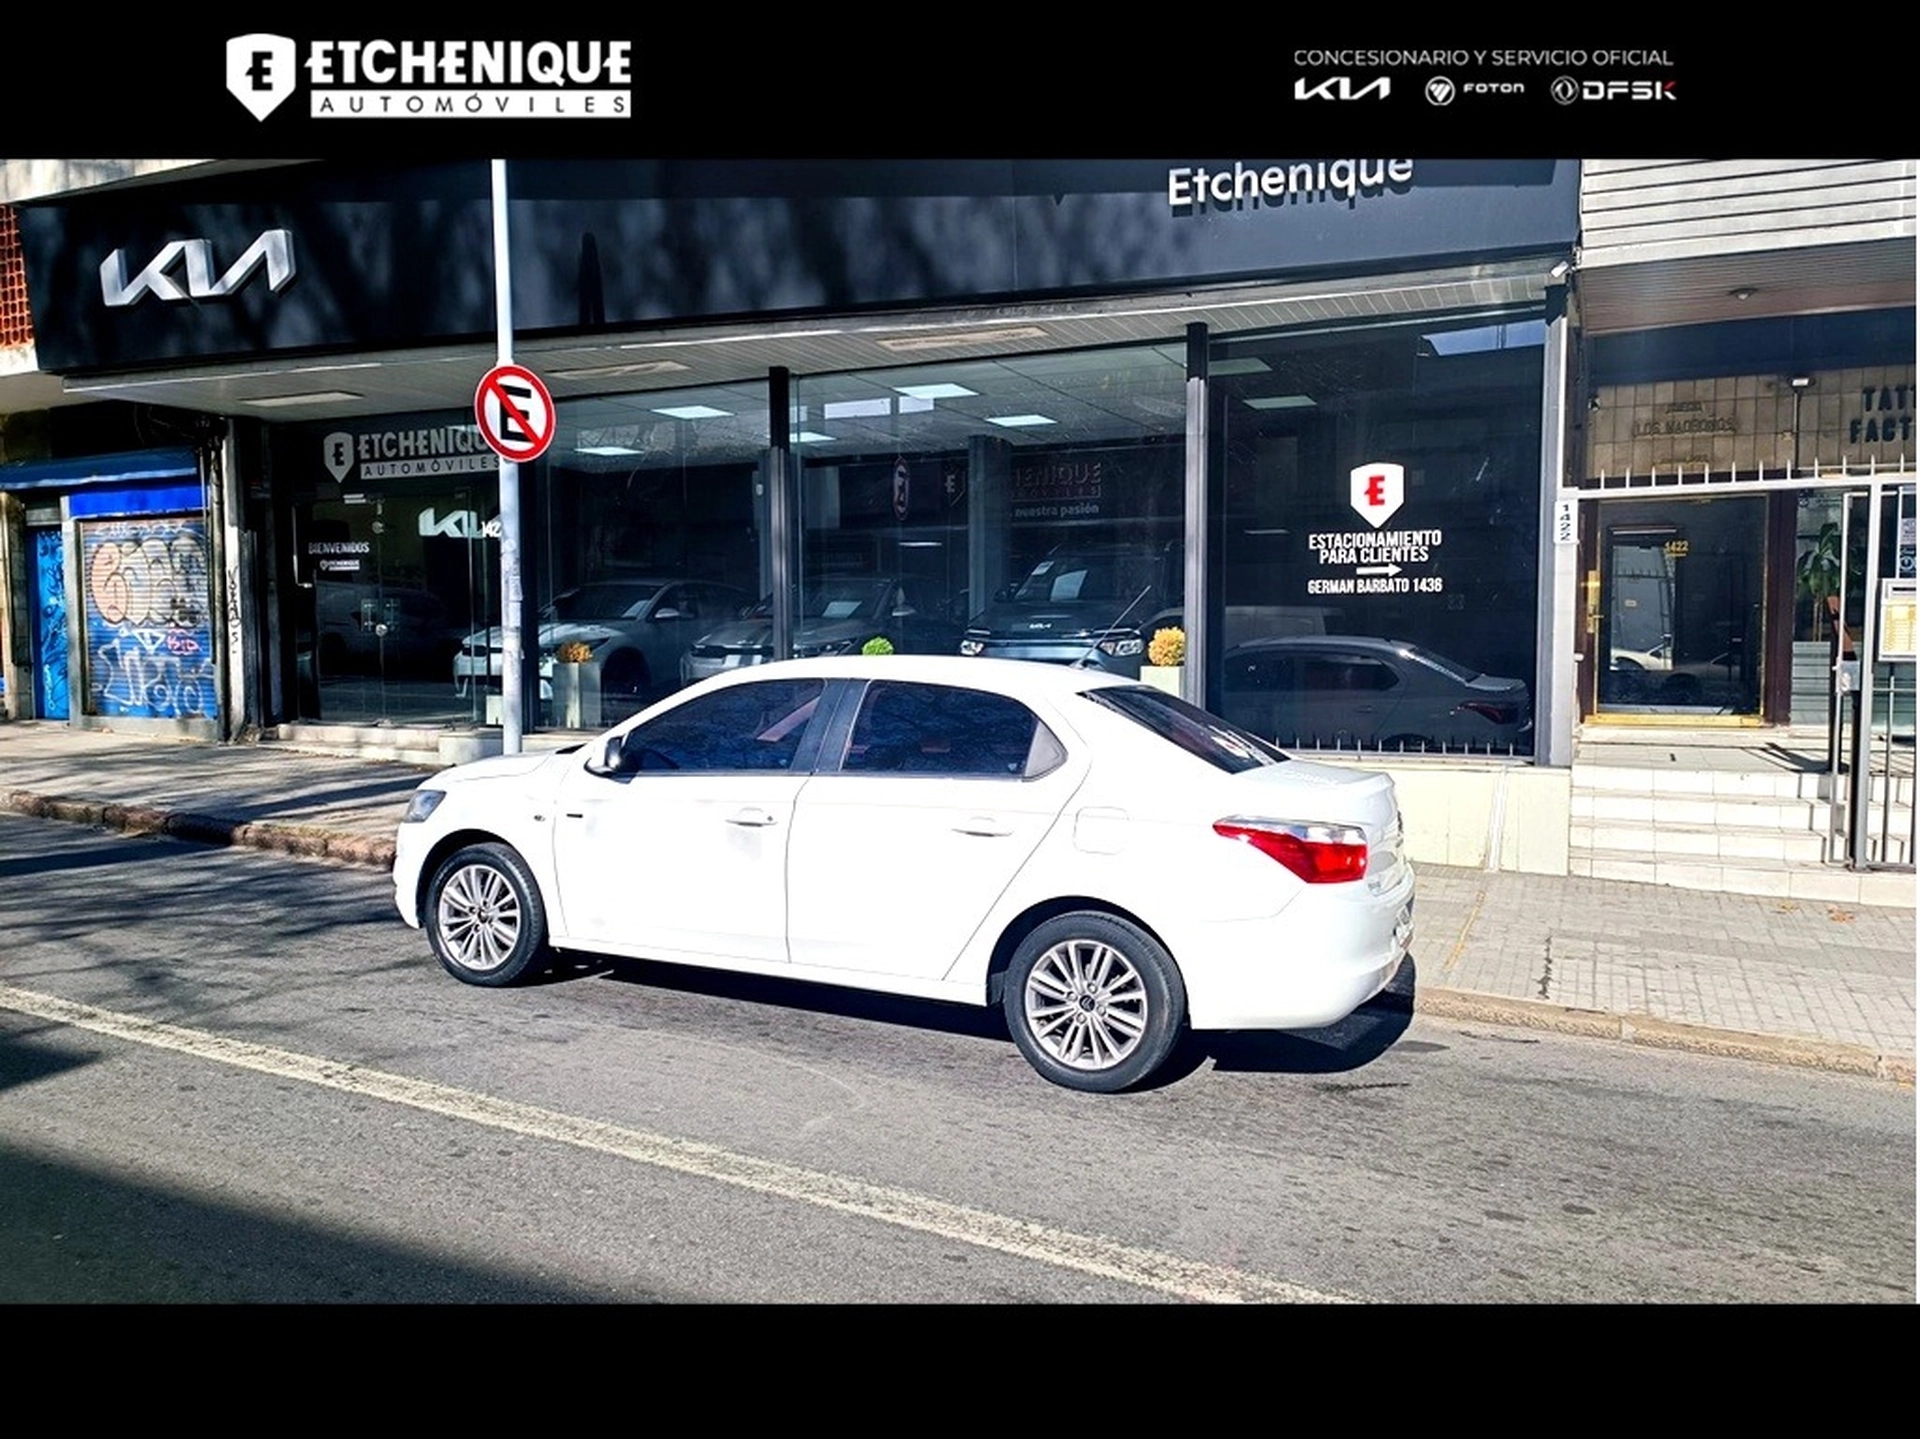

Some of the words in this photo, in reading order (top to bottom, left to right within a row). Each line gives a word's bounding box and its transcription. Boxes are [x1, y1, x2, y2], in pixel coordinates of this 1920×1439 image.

[1168, 159, 1413, 206] Etchenique
[99, 229, 296, 307] KIA
[1863, 384, 1916, 412] TAT
[357, 428, 487, 459] ETCHENIQU
[1308, 529, 1442, 550] ESTACIONAMIENTO
[1319, 548, 1357, 565] PARA
[1360, 546, 1429, 563] CLIENTES
[1307, 579, 1355, 594] GERMAN
[1356, 578, 1409, 594] BARBATO
